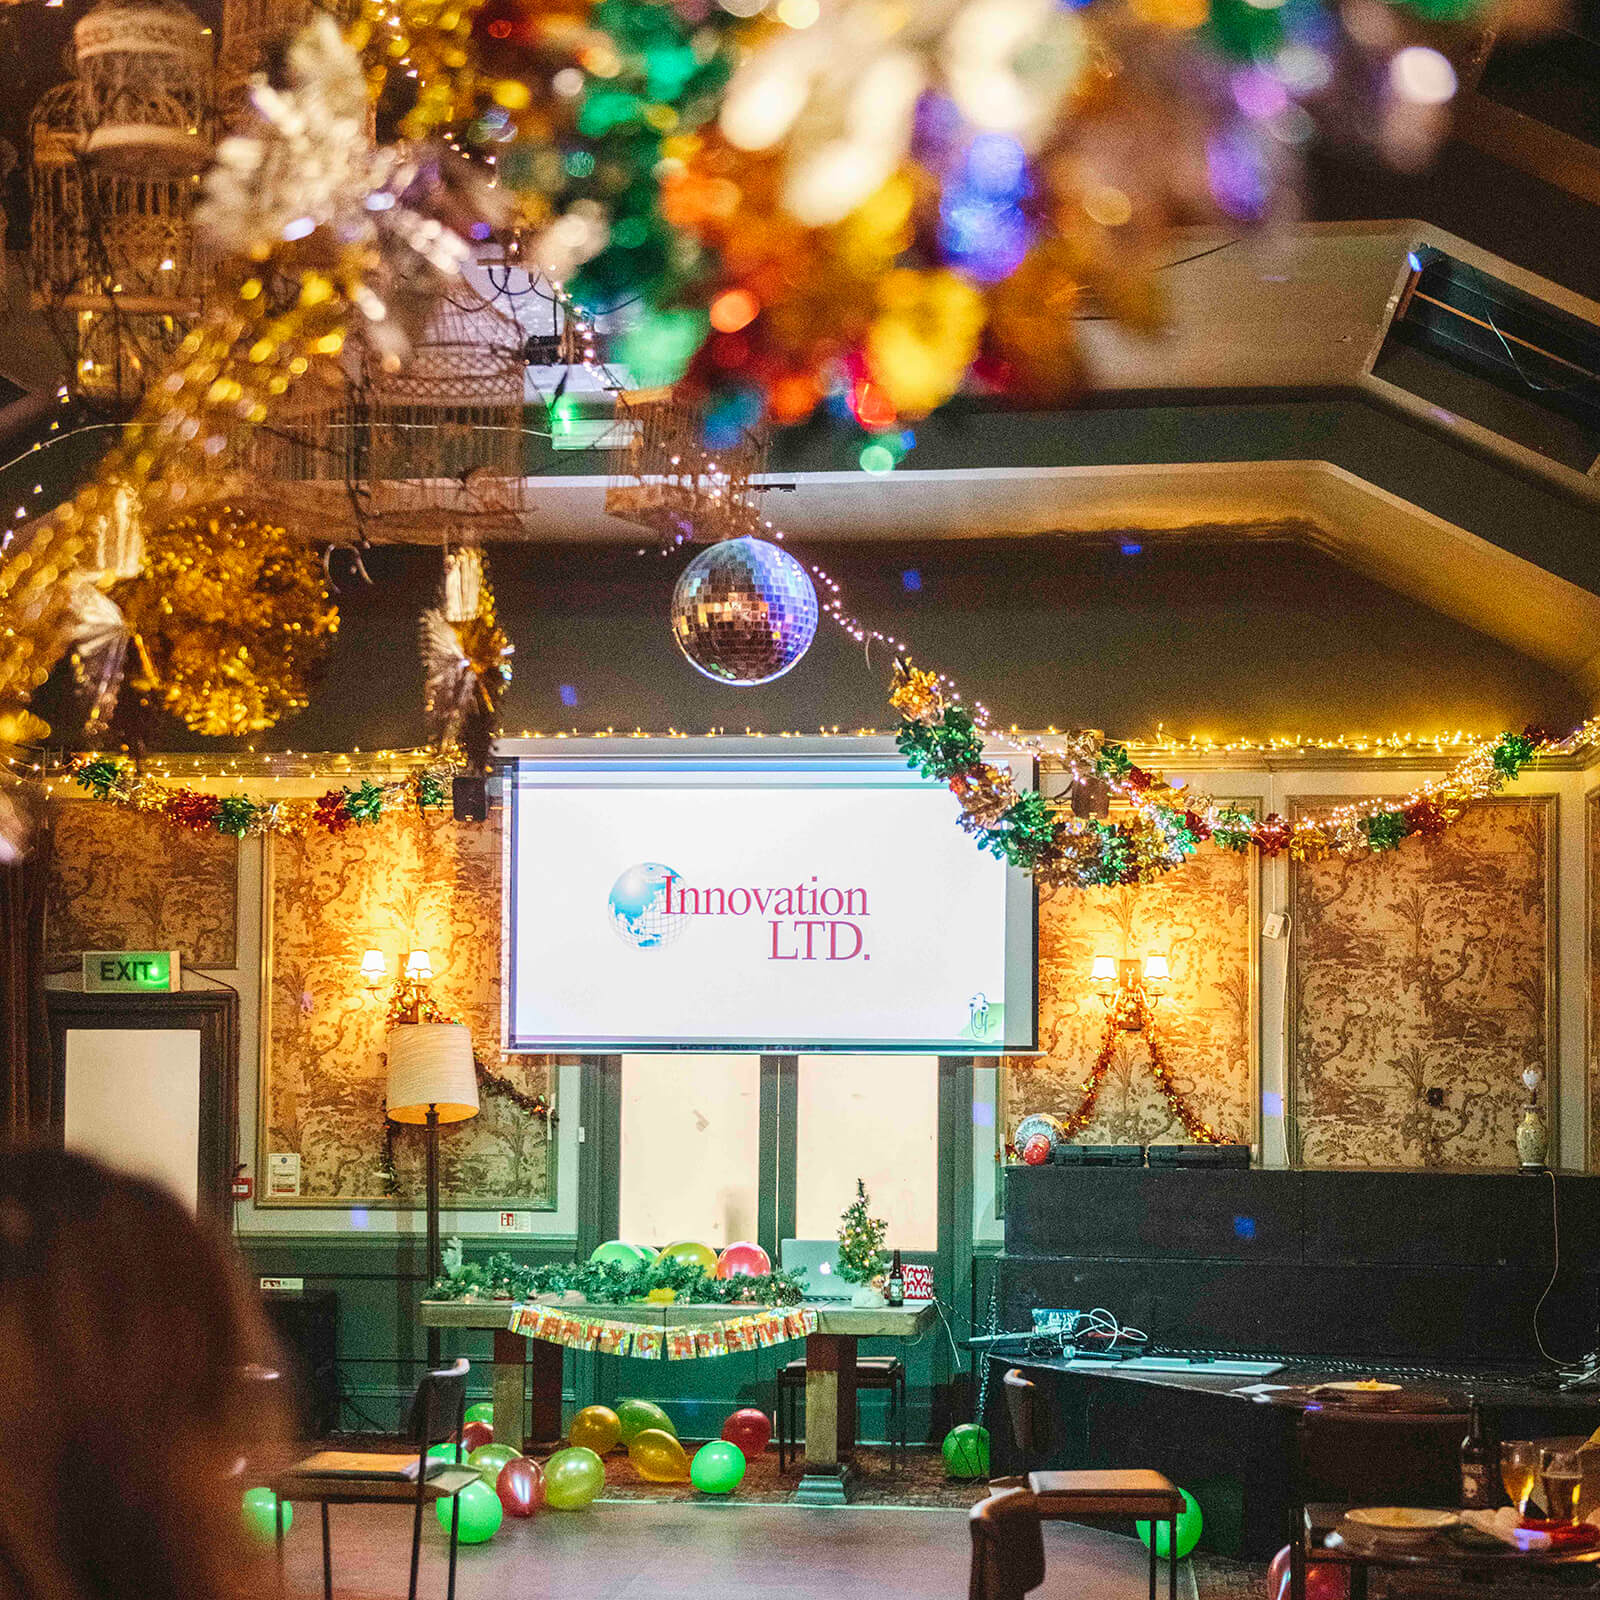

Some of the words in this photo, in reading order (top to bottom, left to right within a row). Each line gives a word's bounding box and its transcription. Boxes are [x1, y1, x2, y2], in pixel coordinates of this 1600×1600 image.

[660, 875, 871, 916] Innovation
[767, 920, 871, 961] LTD.
[101, 961, 153, 981] EXIT
[518, 1309, 625, 1346] MERRY
